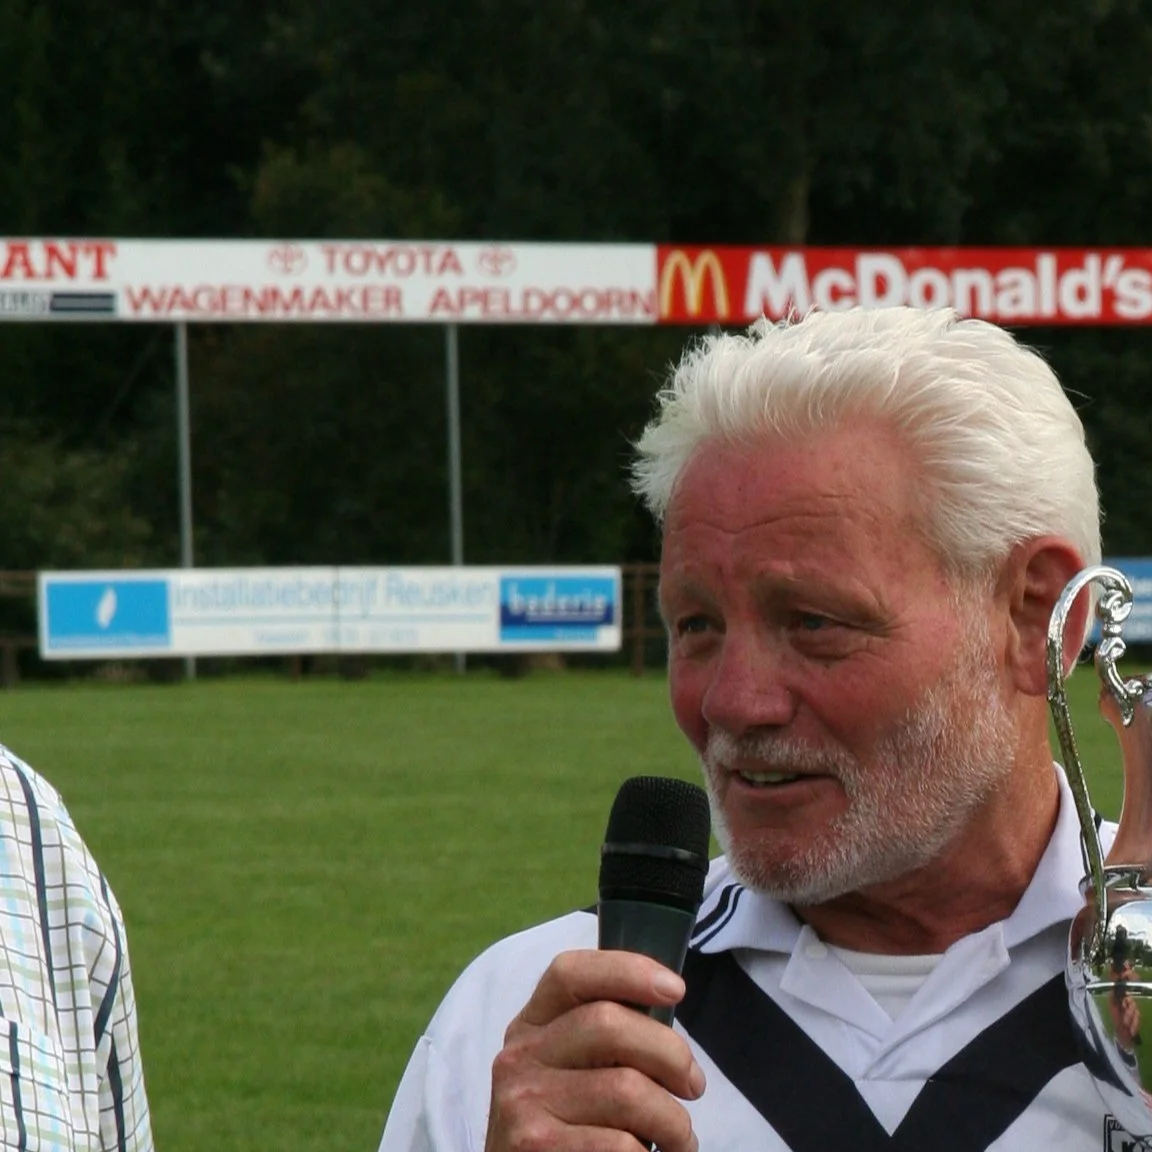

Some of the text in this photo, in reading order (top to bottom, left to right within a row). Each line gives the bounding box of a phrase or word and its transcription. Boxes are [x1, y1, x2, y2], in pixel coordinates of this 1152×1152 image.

[1, 240, 117, 280] ANT
[320, 243, 464, 278] TOYOTA
[124, 285, 658, 317] WAGENMAKER APELDOORN
